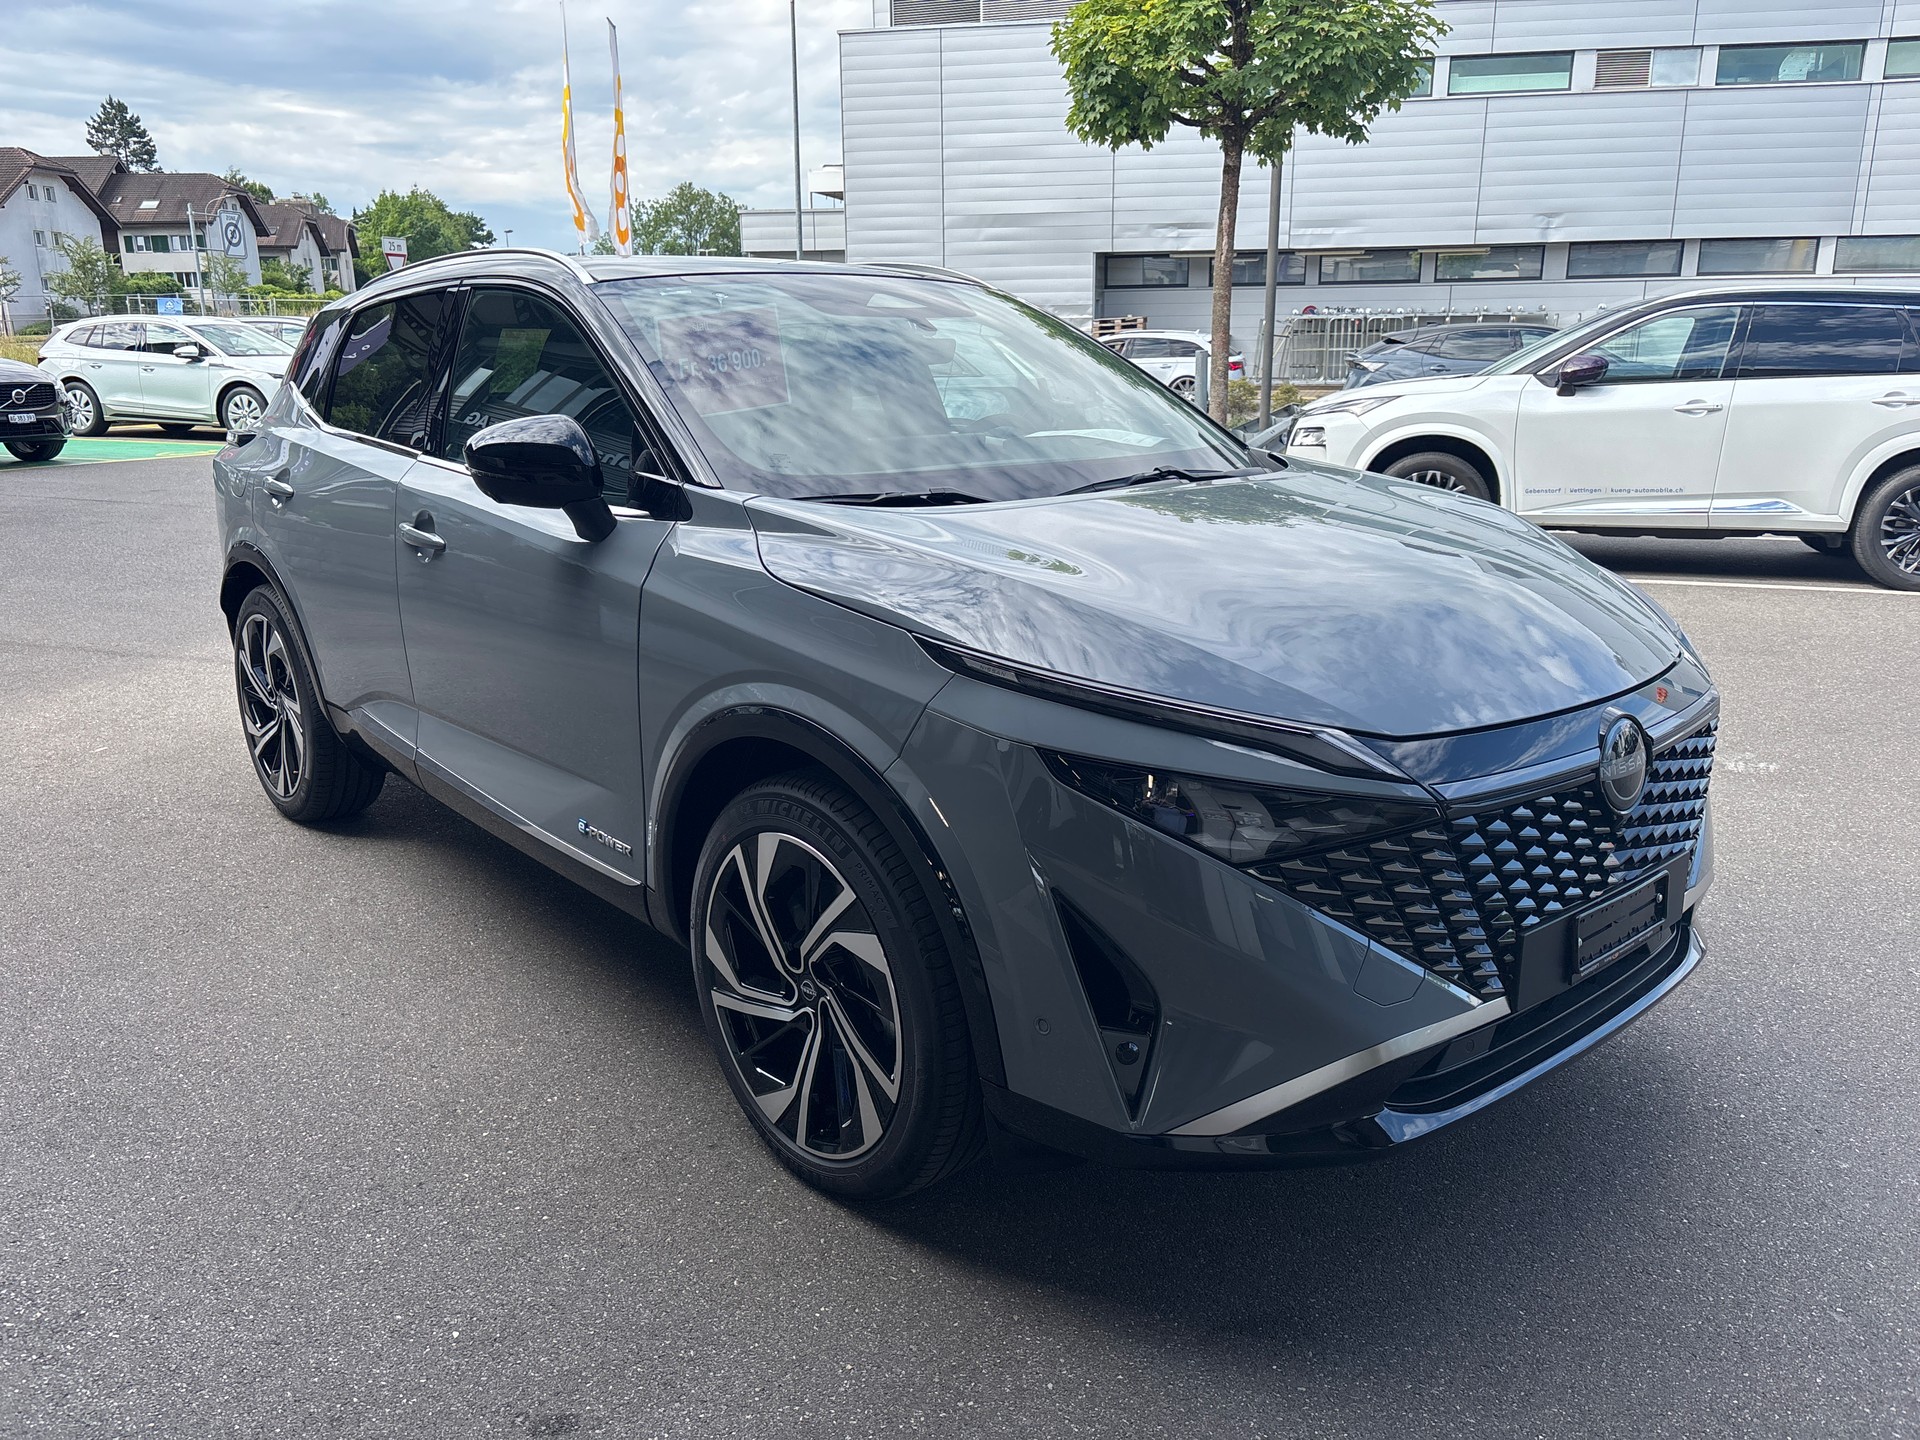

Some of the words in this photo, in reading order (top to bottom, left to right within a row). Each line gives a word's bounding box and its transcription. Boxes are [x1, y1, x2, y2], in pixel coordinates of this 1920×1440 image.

[388, 241, 396, 251] 25
[679, 357, 704, 380] Fr.
[979, 664, 1007, 677] NISSAN
[1600, 753, 1645, 778] NISSA
[757, 799, 847, 852] MICHELIN
[855, 862, 890, 914] PRIMACY
